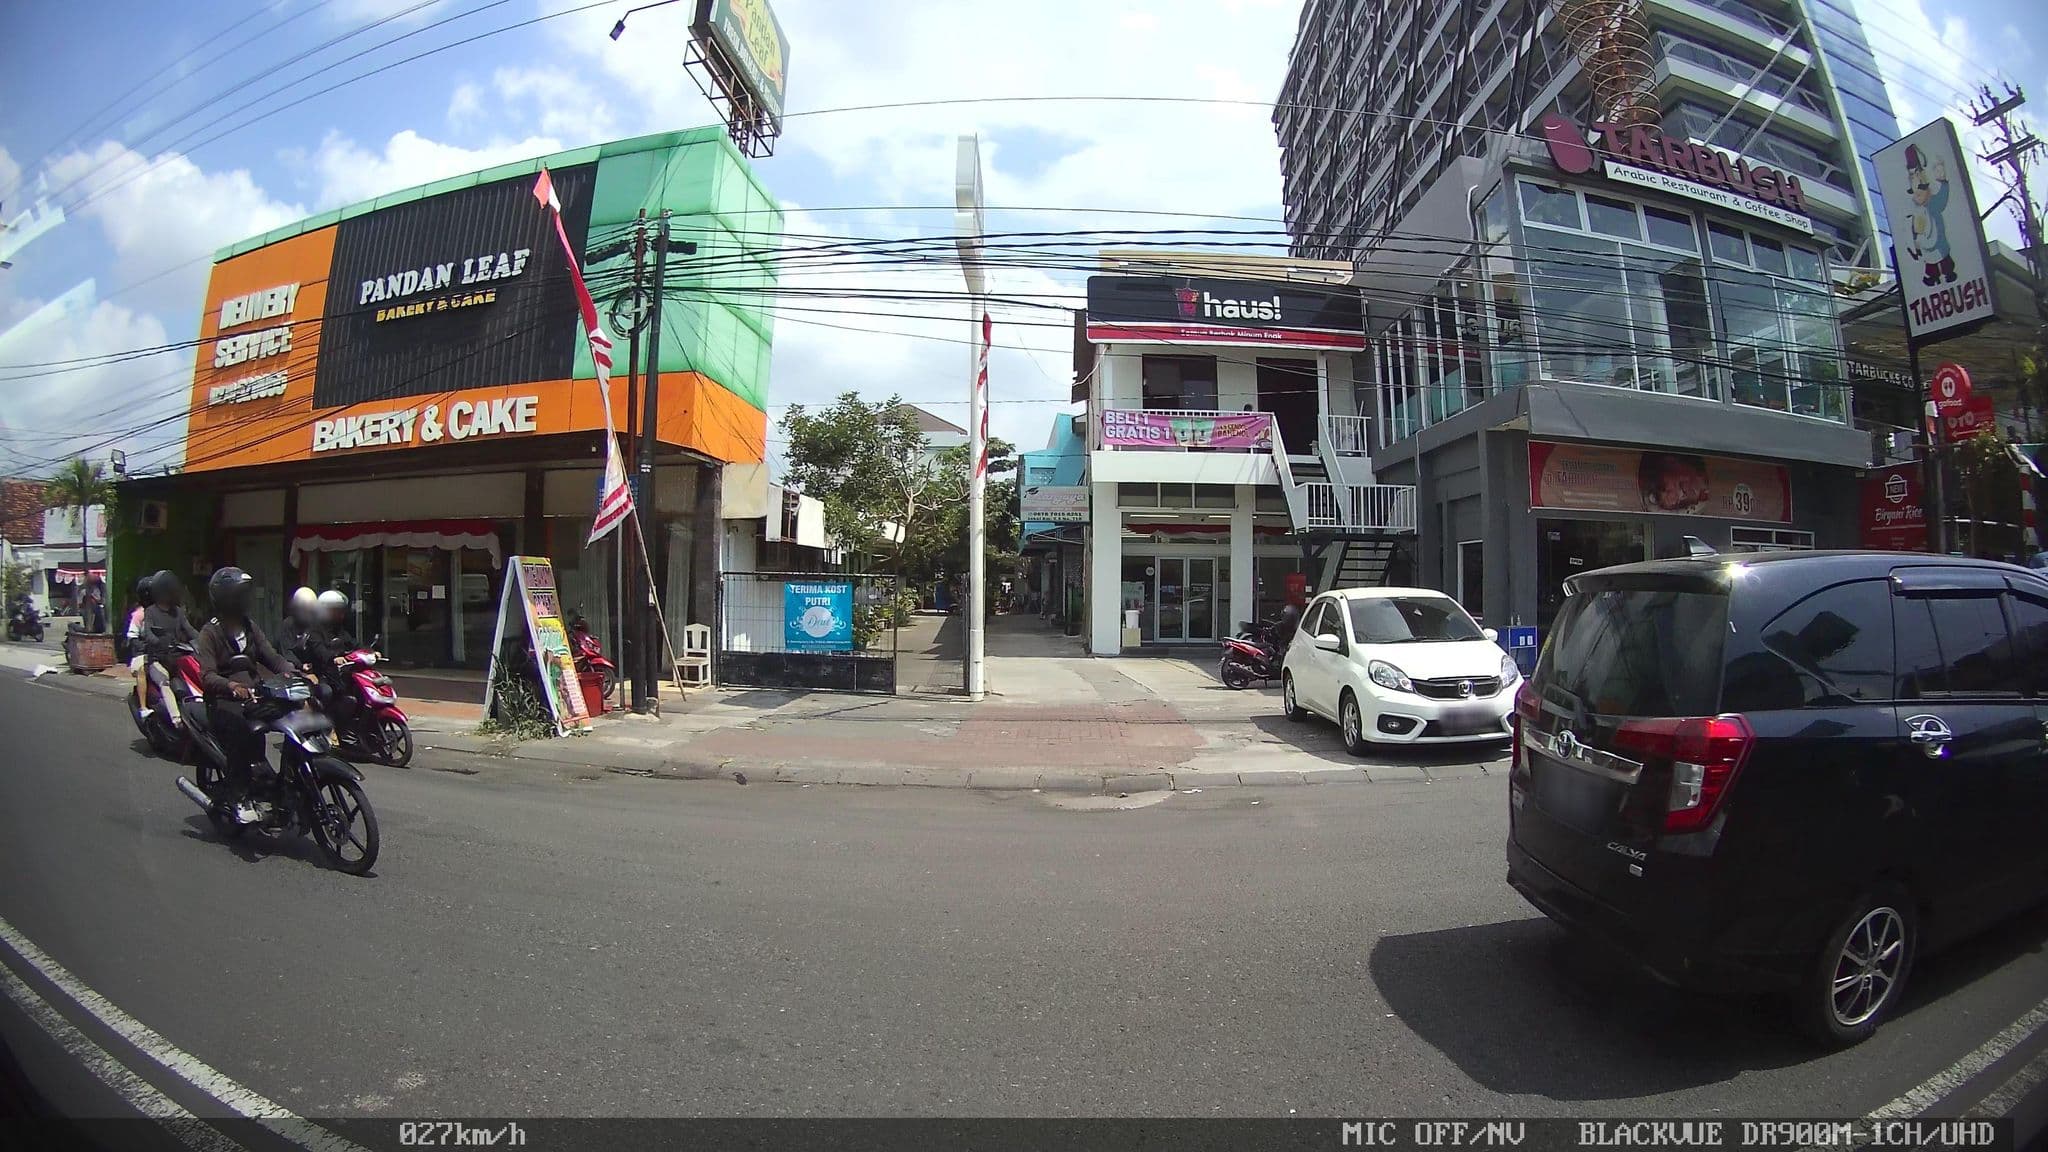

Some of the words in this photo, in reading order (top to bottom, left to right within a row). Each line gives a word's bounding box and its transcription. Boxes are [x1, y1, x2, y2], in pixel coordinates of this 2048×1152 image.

[1592, 119, 1807, 212] TARBUSH
[1613, 166, 1657, 185] Arabic
[1661, 177, 1728, 203] Restaurant
[1733, 197, 1741, 207] &
[1744, 200, 1781, 220] Coffee
[1785, 212, 1809, 229] Shop
[359, 262, 455, 305] PANDAN
[461, 248, 531, 285] LEAF
[375, 299, 436, 323] BAKERY
[451, 288, 496, 309] CAKE
[1203, 291, 1282, 320] haus!
[1909, 277, 1989, 326] TARBUSH
[214, 320, 295, 368] SERVICE
[313, 408, 419, 452] BAKERY
[421, 405, 444, 442] &
[449, 396, 538, 440] CAKE
[1104, 411, 1139, 425] BELI
[1105, 425, 1161, 440] GRATIS
[1163, 426, 1170, 440] 1
[1735, 492, 1750, 511] 39
[790, 584, 823, 594] TERIMA
[824, 585, 848, 594] KOST
[805, 596, 831, 606] PUTRI
